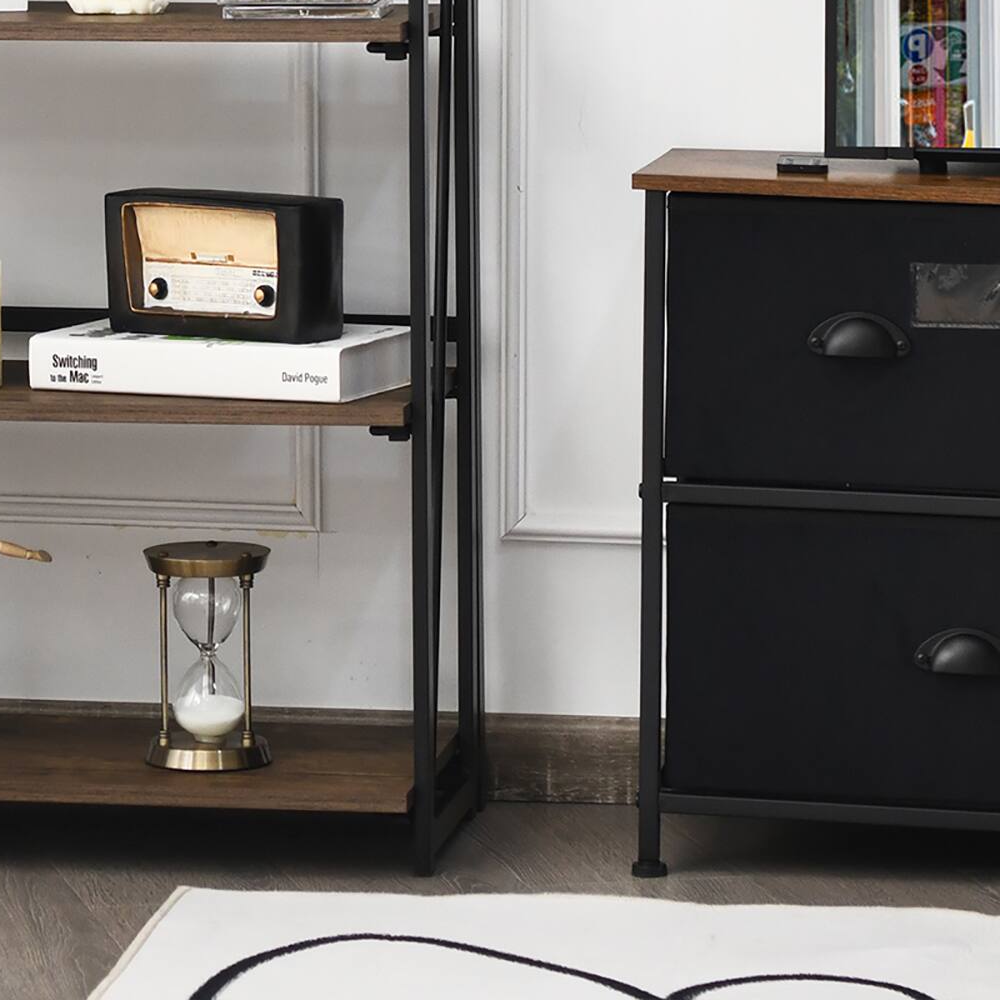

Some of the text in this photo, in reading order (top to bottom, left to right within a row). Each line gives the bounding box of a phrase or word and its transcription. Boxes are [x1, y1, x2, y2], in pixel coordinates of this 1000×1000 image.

[52, 353, 98, 371] Switching
[49, 374, 56, 382] to
[57, 374, 67, 383] the
[69, 370, 89, 383] Mac
[282, 371, 328, 386] David Pogue
